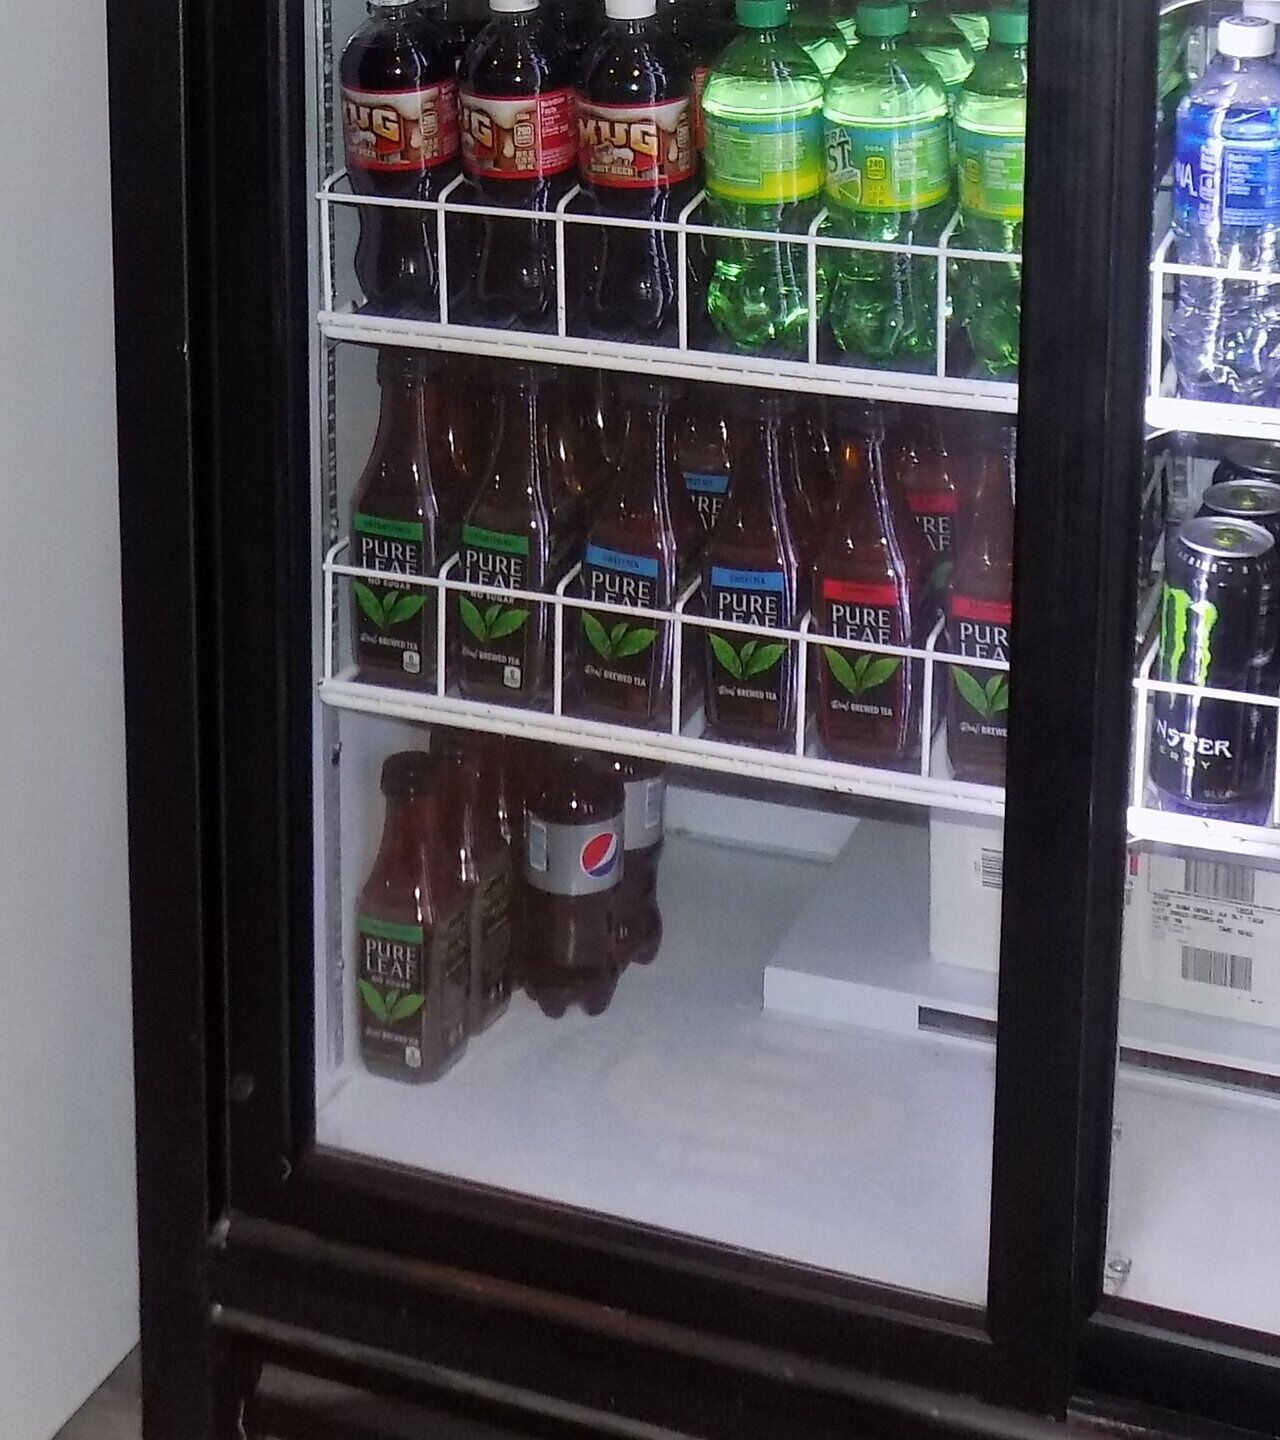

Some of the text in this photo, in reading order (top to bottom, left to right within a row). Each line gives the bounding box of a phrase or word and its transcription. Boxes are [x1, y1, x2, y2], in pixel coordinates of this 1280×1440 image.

[578, 118, 658, 157] MUG
[869, 160, 883, 169] 240
[362, 537, 418, 563] PURE
[466, 550, 523, 577] PURE
[382, 579, 412, 591] SUGAR
[591, 570, 652, 601] PURE
[486, 593, 515, 605] SUGAR
[719, 591, 778, 615] PURE
[832, 603, 891, 629] PURE
[378, 635, 406, 649] BREWED
[406, 641, 419, 651] TEA
[479, 650, 507, 663] BREWED
[507, 657, 521, 667] TEA
[603, 669, 633, 685] BREWED
[633, 675, 647, 688] TEA
[736, 688, 765, 700] BREWED
[765, 691, 778, 701] TEA
[850, 702, 880, 715] BREWED
[881, 707, 894, 718] TEA
[365, 938, 417, 962] PURE
[365, 954, 417, 980] LEAF
